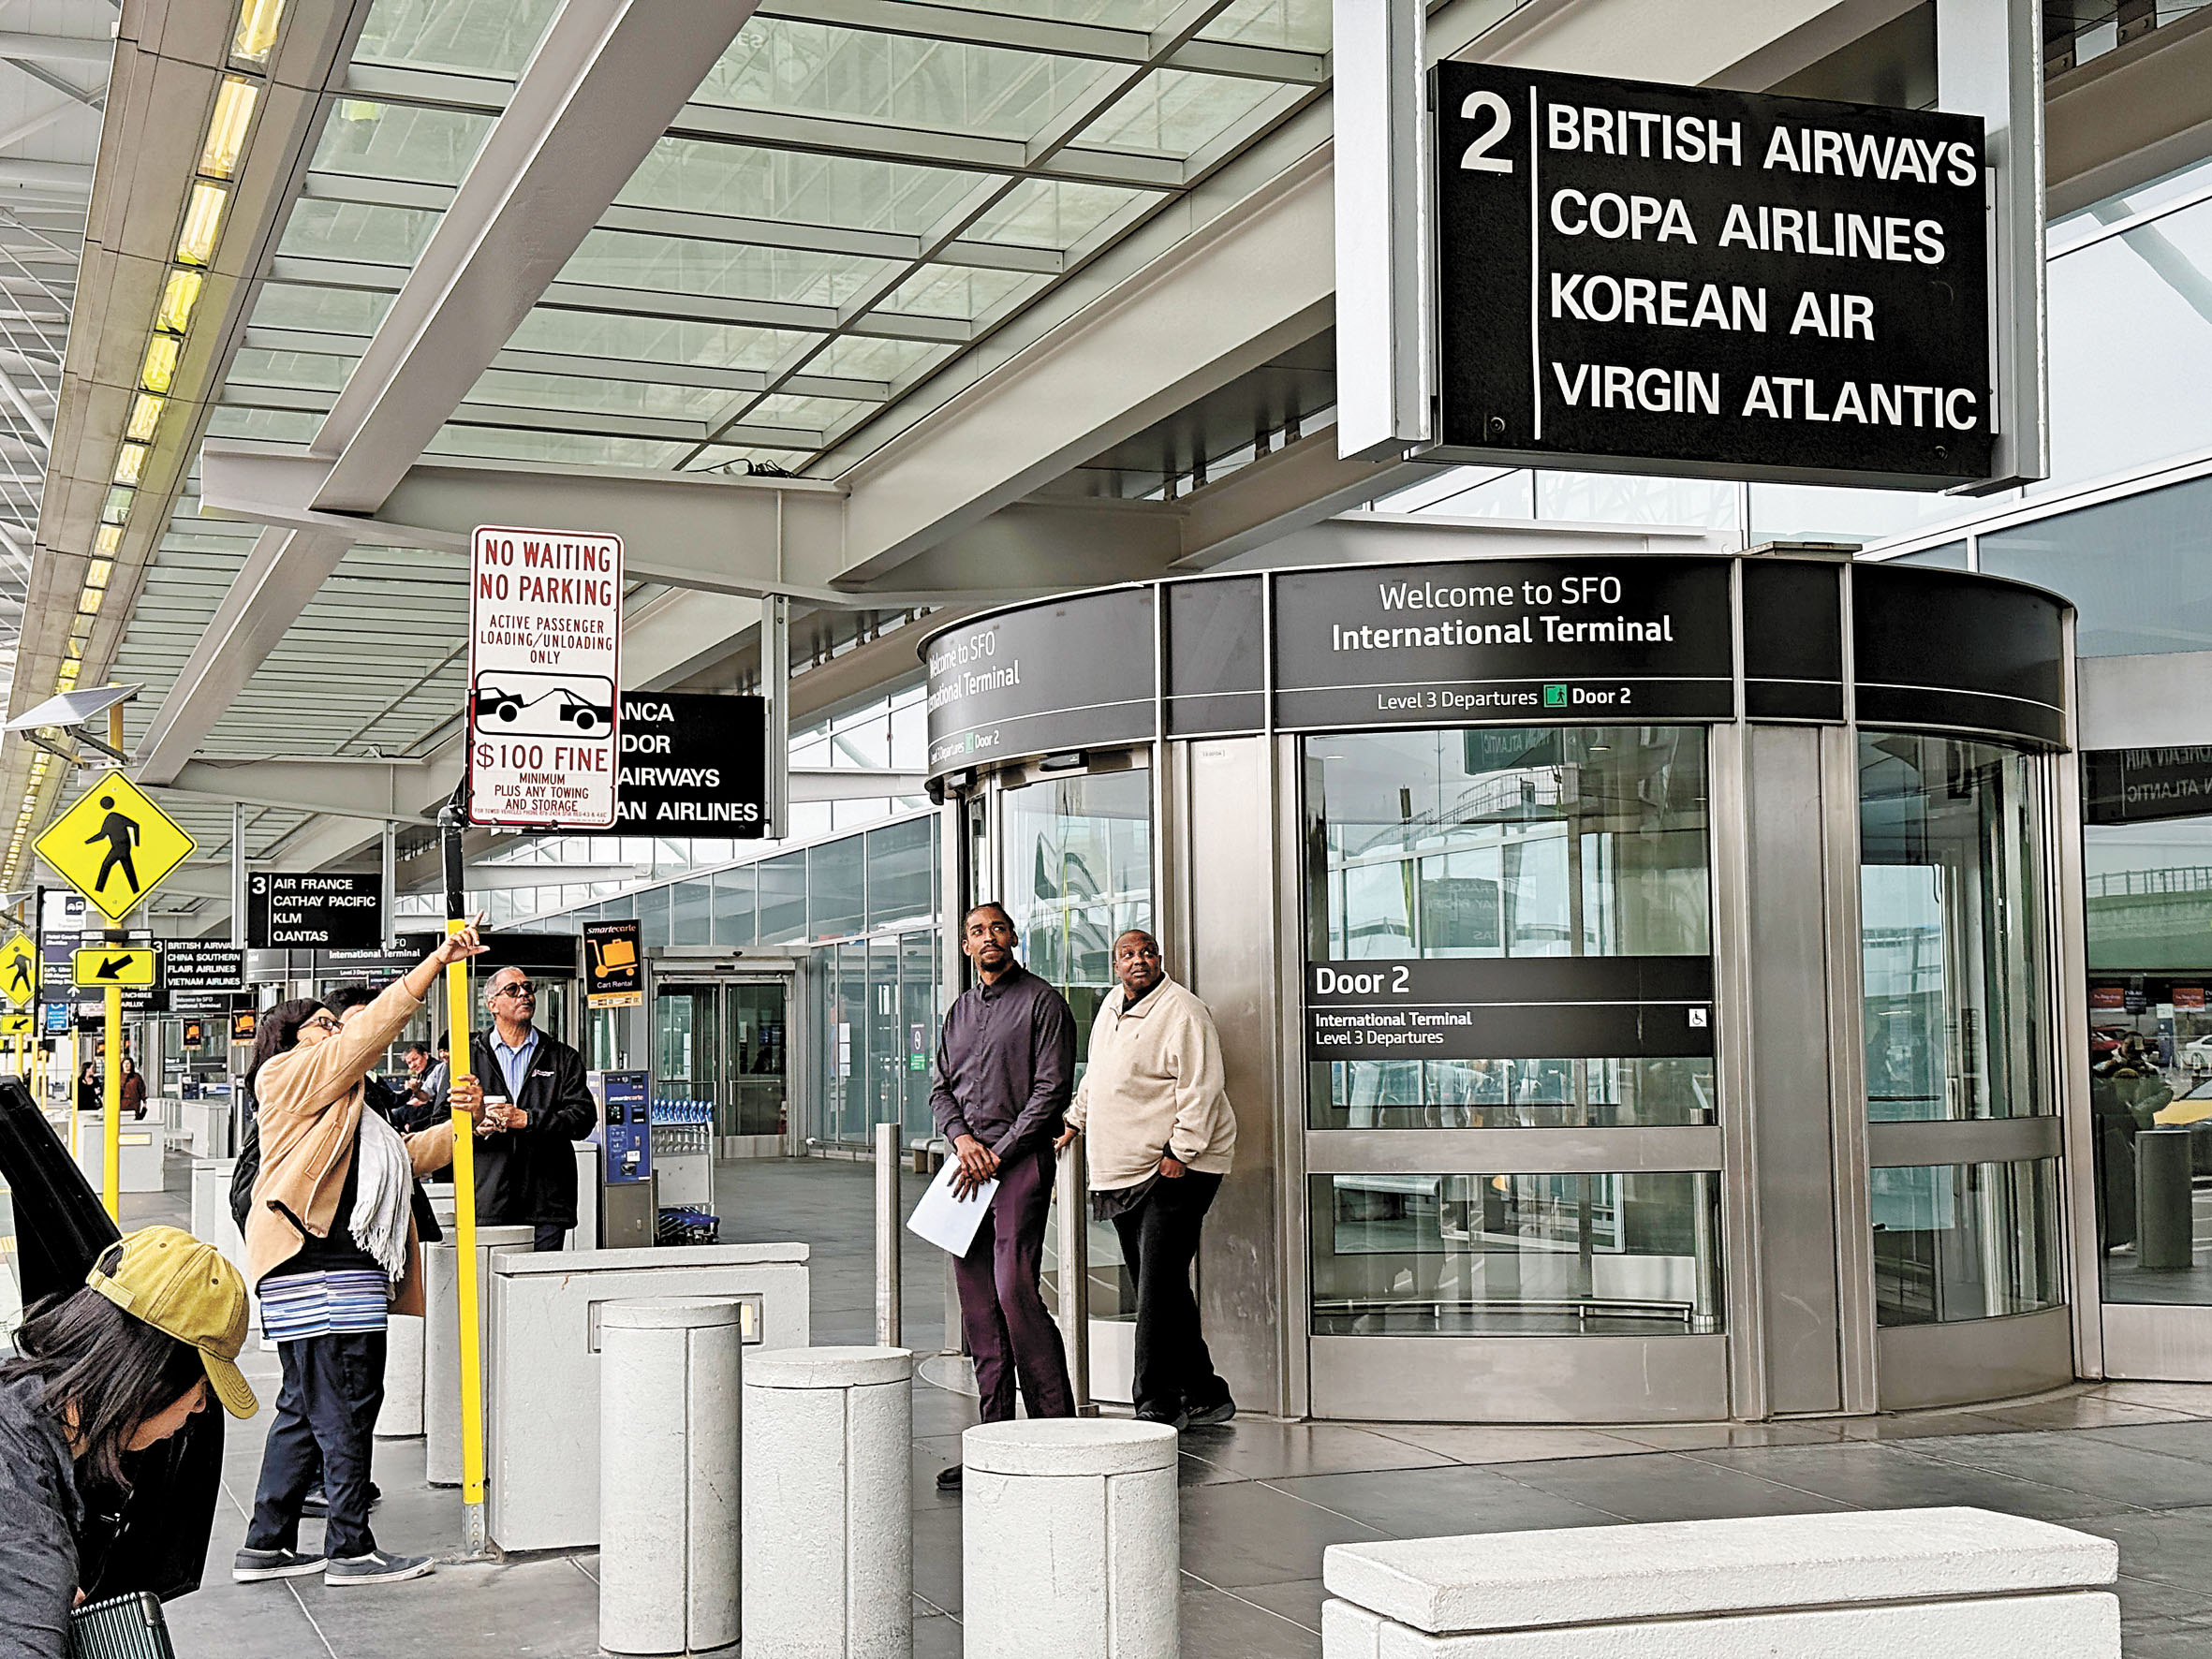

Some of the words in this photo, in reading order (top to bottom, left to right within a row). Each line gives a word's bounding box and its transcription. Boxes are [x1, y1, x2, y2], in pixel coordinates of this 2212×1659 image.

[1460, 91, 1513, 174] 2
[1548, 103, 1742, 167] BRITISH
[1763, 125, 1977, 187] AIRWAYS
[1550, 188, 1697, 245] COPA
[1718, 203, 1945, 264] AIRLINES
[1551, 272, 1767, 333] KOREAN
[1790, 292, 1874, 342] AIR
[1552, 362, 1719, 415] VIRGIN
[1742, 375, 1977, 431] ATLANTIC
[485, 539, 514, 566] NO
[524, 541, 611, 572] WAITING
[479, 573, 509, 601] NO
[519, 576, 612, 607] PARKING
[1379, 581, 1514, 610] Welcome
[1522, 580, 1553, 605] to
[1561, 577, 1621, 604] SFO
[490, 614, 531, 630] ACTIVE
[537, 617, 604, 634] PASSENGER
[1333, 616, 1533, 651] International
[1540, 614, 1674, 642] Terminal
[480, 630, 612, 651] LOADING/UNLOADING
[958, 644, 968, 665] to
[970, 631, 995, 660] SFO
[530, 650, 561, 665] ONLY
[964, 659, 1020, 696] Terminal
[1378, 692, 1423, 710] Level
[1426, 691, 1438, 708] 3
[1441, 690, 1538, 711] Departures
[1572, 688, 1615, 704] Door
[1620, 687, 1631, 704] 2
[975, 734, 993, 749] Door
[994, 730, 999, 745] 2
[476, 742, 543, 770] $100
[554, 746, 609, 771] FINE
[519, 772, 566, 785] MINIMUM
[618, 767, 720, 787] AIRWAYS
[494, 785, 521, 797] PLUS
[525, 786, 546, 798] ANY
[551, 787, 589, 800] TOWING
[506, 799, 527, 811] AND
[531, 800, 578, 812] STORAGE
[656, 802, 759, 822] AIRLINES
[252, 876, 266, 894] 3
[273, 879, 296, 889] AIR
[301, 879, 353, 890] FRANCE
[273, 896, 324, 906] CATHAY
[329, 896, 376, 907] PACIFIC
[273, 913, 302, 924] KLM
[273, 931, 329, 942] QANTAS
[153, 941, 163, 954] 3
[330, 949, 381, 959] International
[383, 948, 420, 958] Terminal
[168, 977, 204, 986] VIETNAM
[206, 977, 241, 986] AIRLINES
[1316, 967, 1385, 994] Door
[1392, 965, 1409, 993] 2
[1316, 1012, 1406, 1027] International
[1408, 1011, 1473, 1026] Terminal
[1316, 1031, 1351, 1045] Level
[1354, 1031, 1364, 1044] 3
[1366, 1030, 1444, 1048] Departures
